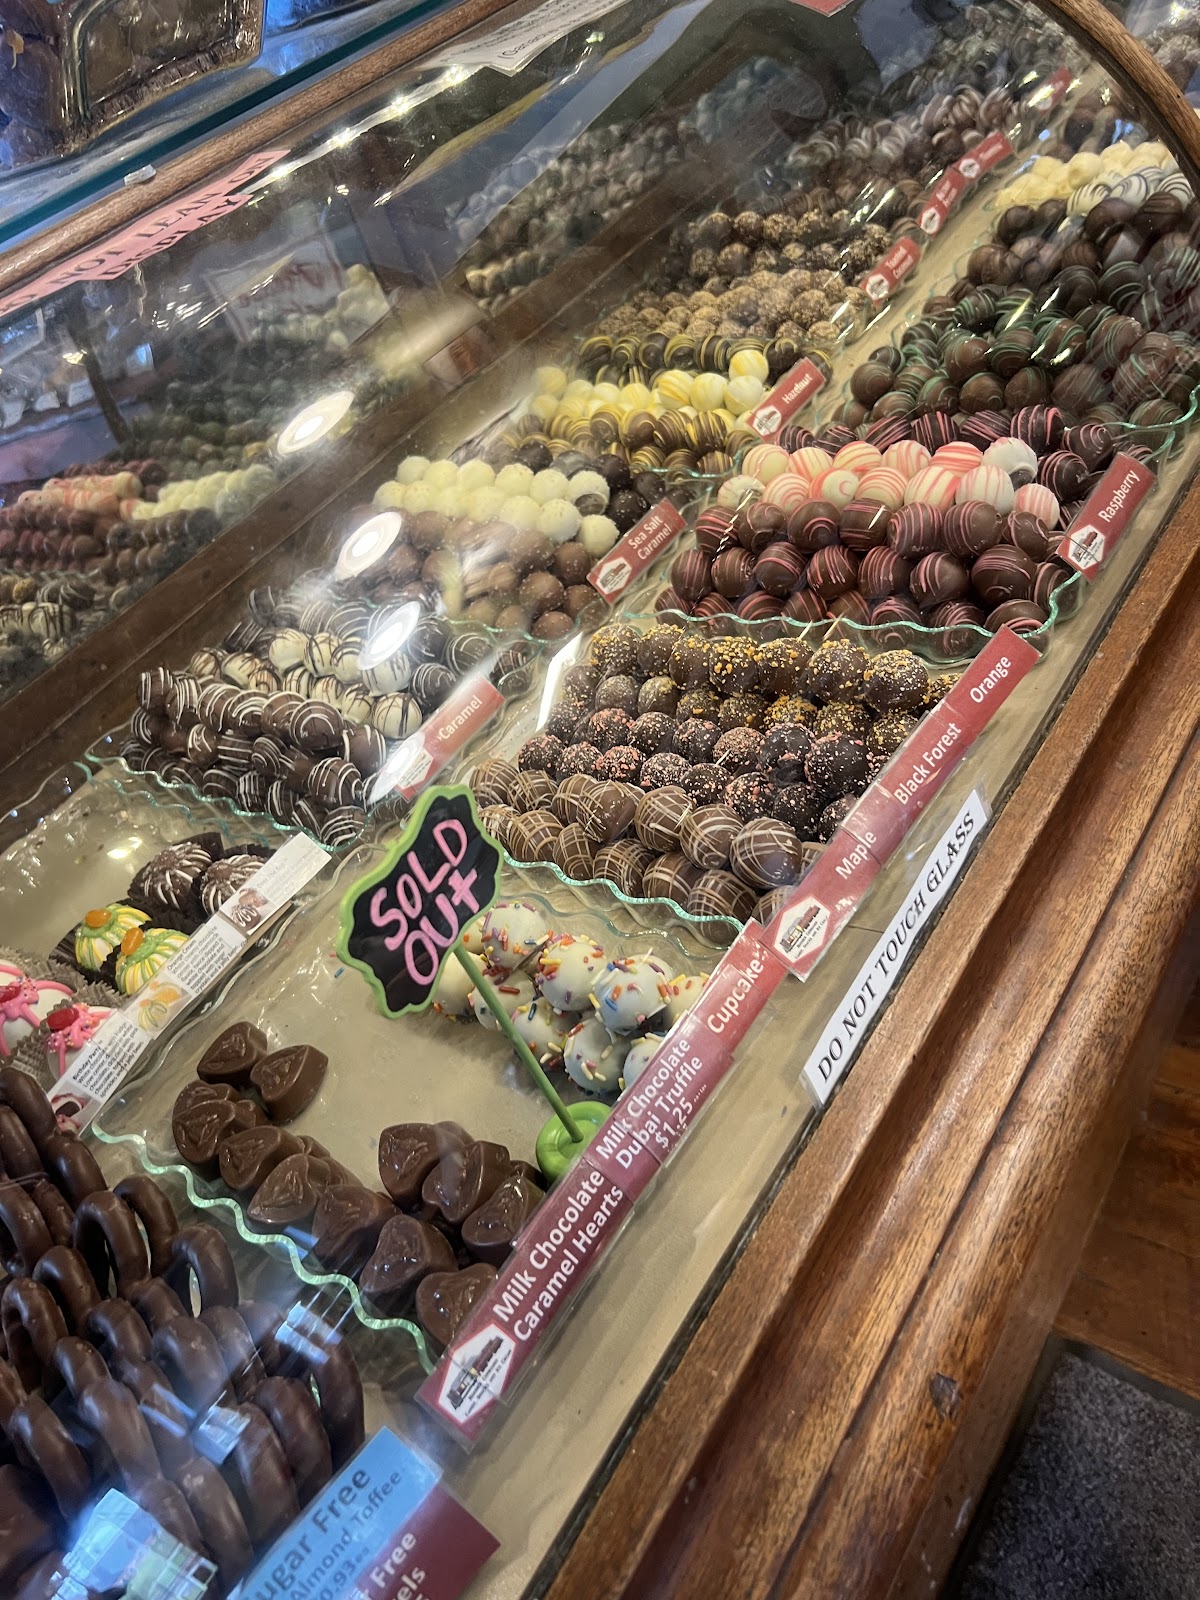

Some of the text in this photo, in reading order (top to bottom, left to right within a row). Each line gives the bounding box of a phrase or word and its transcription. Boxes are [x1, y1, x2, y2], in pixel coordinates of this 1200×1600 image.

[46, 250, 126, 285] NOT
[136, 192, 222, 239] LEAN
[229, 157, 275, 185] ON
[781, 373, 813, 404] Hazelnut
[1098, 470, 1141, 522] Raspberry
[628, 515, 663, 549] Sea Salt
[637, 523, 672, 560] Caramel
[970, 655, 1011, 704] Orange
[439, 695, 482, 739] Caramel
[893, 722, 962, 805] Black Forest
[835, 829, 877, 880] Maple
[370, 818, 468, 951] SOLD
[167, 939, 195, 970] Orange Cream
[186, 944, 224, 985] white chocolate and
[190, 951, 225, 989] topped with sugar
[193, 957, 204, 968] twice
[204, 941, 219, 957] dipped
[817, 812, 975, 1083] DO NOT TOUCH GLASS
[195, 977, 210, 993] crystals
[209, 968, 218, 977] and
[220, 956, 229, 965] jelly
[707, 958, 764, 1034] Cupcake
[72, 1058, 90, 1080] Birthday
[126, 1042, 135, 1052] with
[595, 1038, 691, 1160] Milk Chocolate
[615, 1054, 703, 1169] Dubai Truffle
[655, 1098, 694, 1149] $1.25
[493, 1170, 605, 1323] Milk Chocolate
[513, 1186, 624, 1341] Caramel Hearts
[246, 1467, 371, 1600] ugar Free
[290, 1529, 353, 1600] Almond
[351, 1470, 402, 1528] Toffee
[370, 1531, 417, 1590] Free
